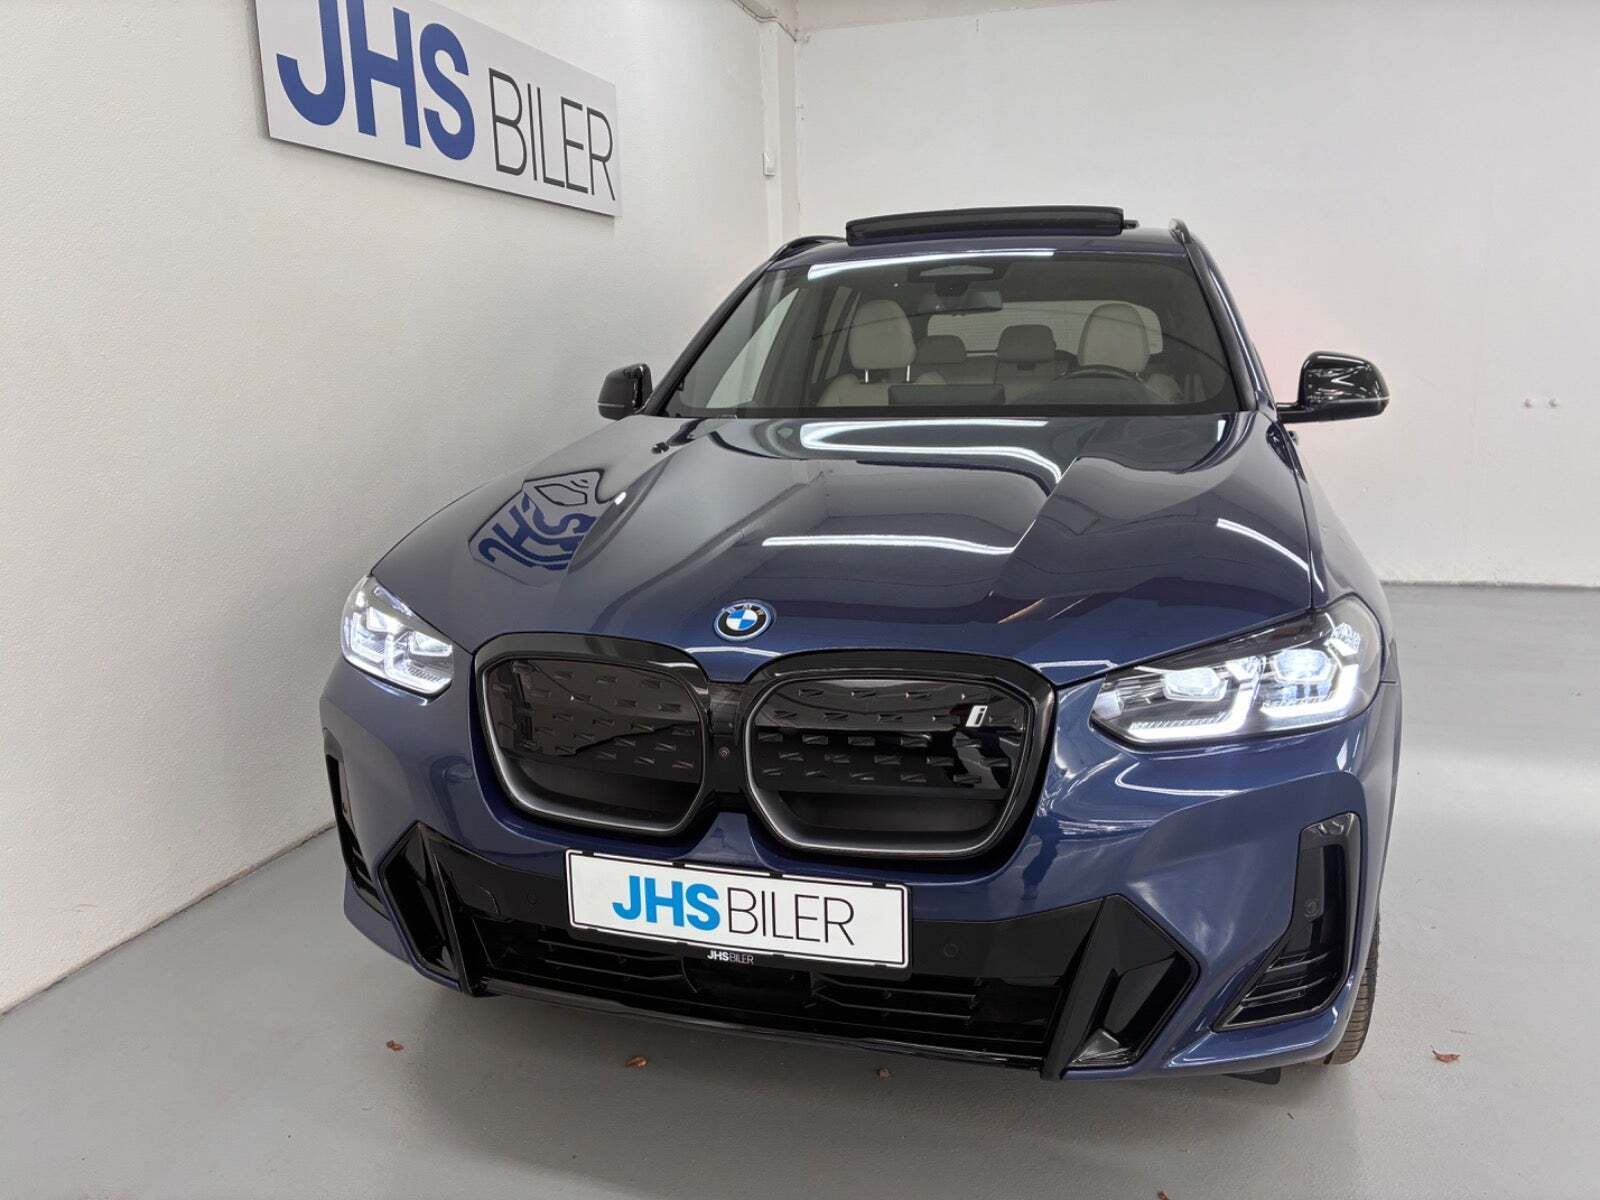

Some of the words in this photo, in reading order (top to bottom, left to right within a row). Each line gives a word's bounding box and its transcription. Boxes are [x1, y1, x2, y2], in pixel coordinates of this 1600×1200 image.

[276, 0, 475, 160] JHS
[489, 68, 615, 200] BILER
[612, 875, 721, 931] JHS
[727, 887, 855, 945] BILER
